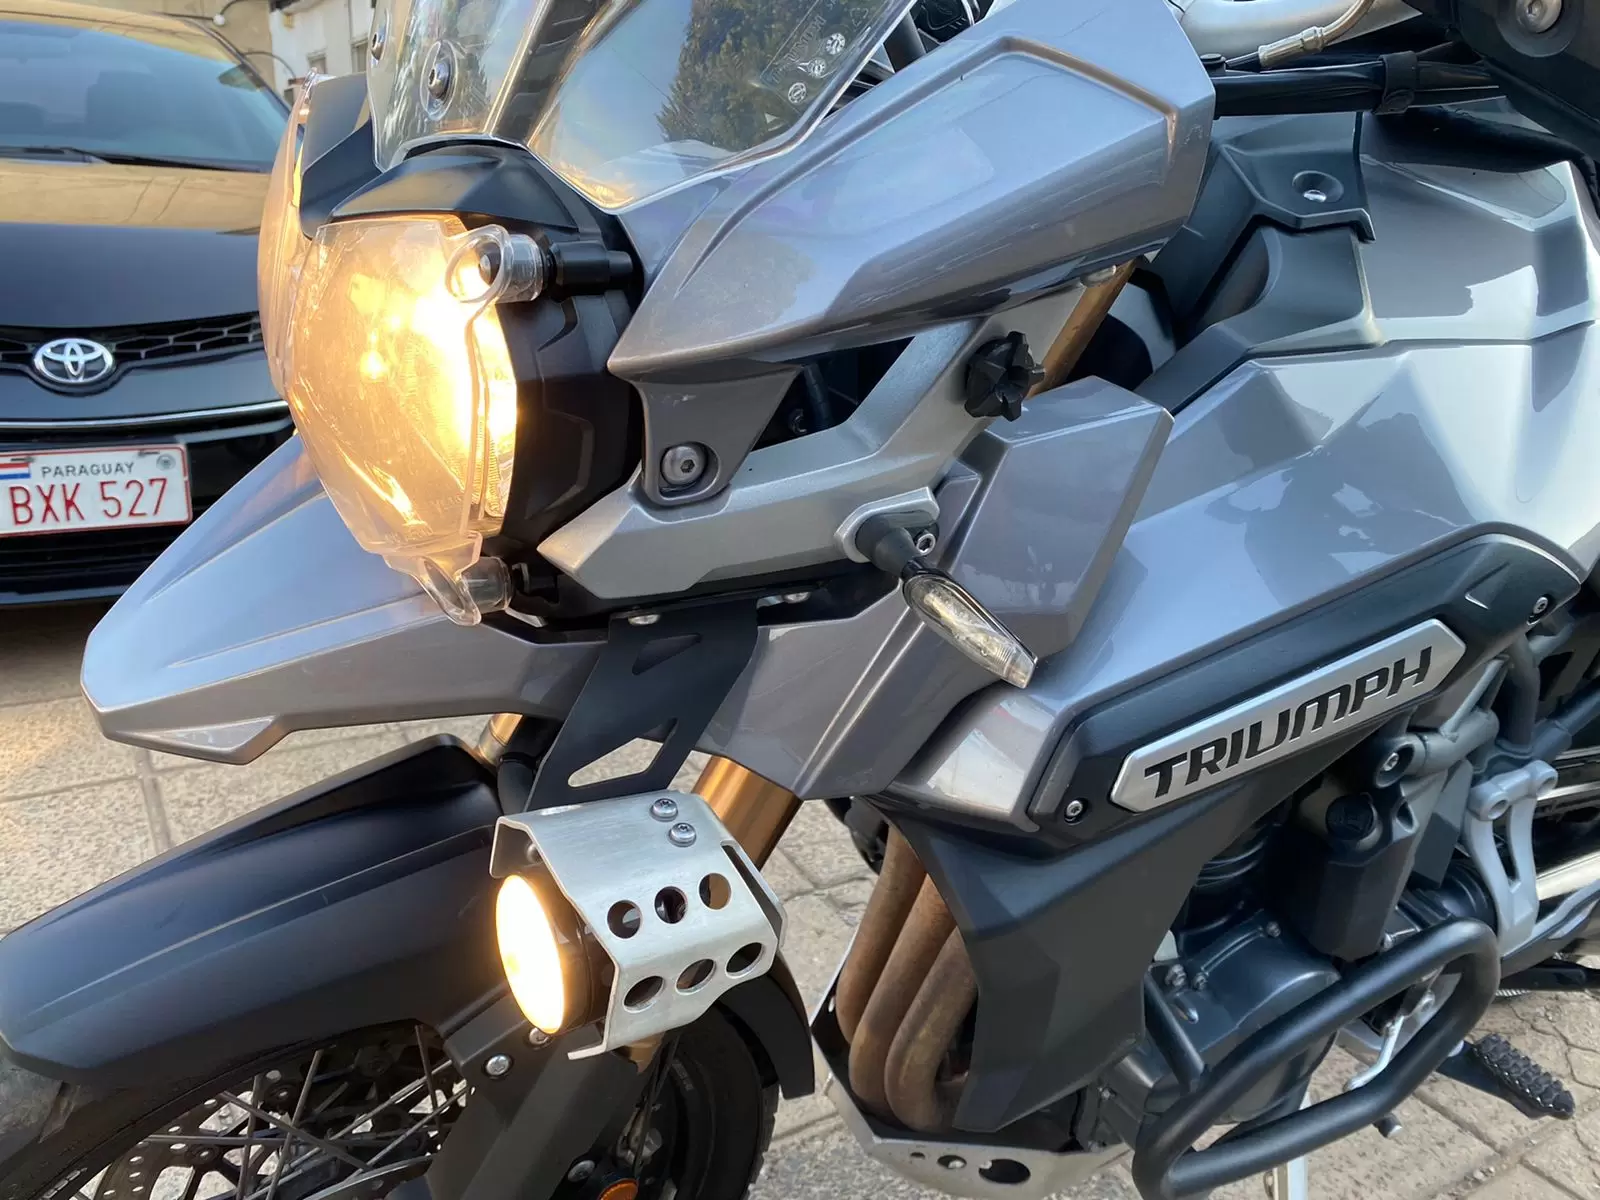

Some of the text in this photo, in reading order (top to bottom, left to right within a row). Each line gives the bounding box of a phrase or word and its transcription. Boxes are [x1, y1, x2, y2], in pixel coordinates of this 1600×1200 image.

[41, 462, 135, 478] PARAGUAY
[9, 478, 168, 525] BXK 527
[1144, 646, 1433, 799] TRIUMPH
